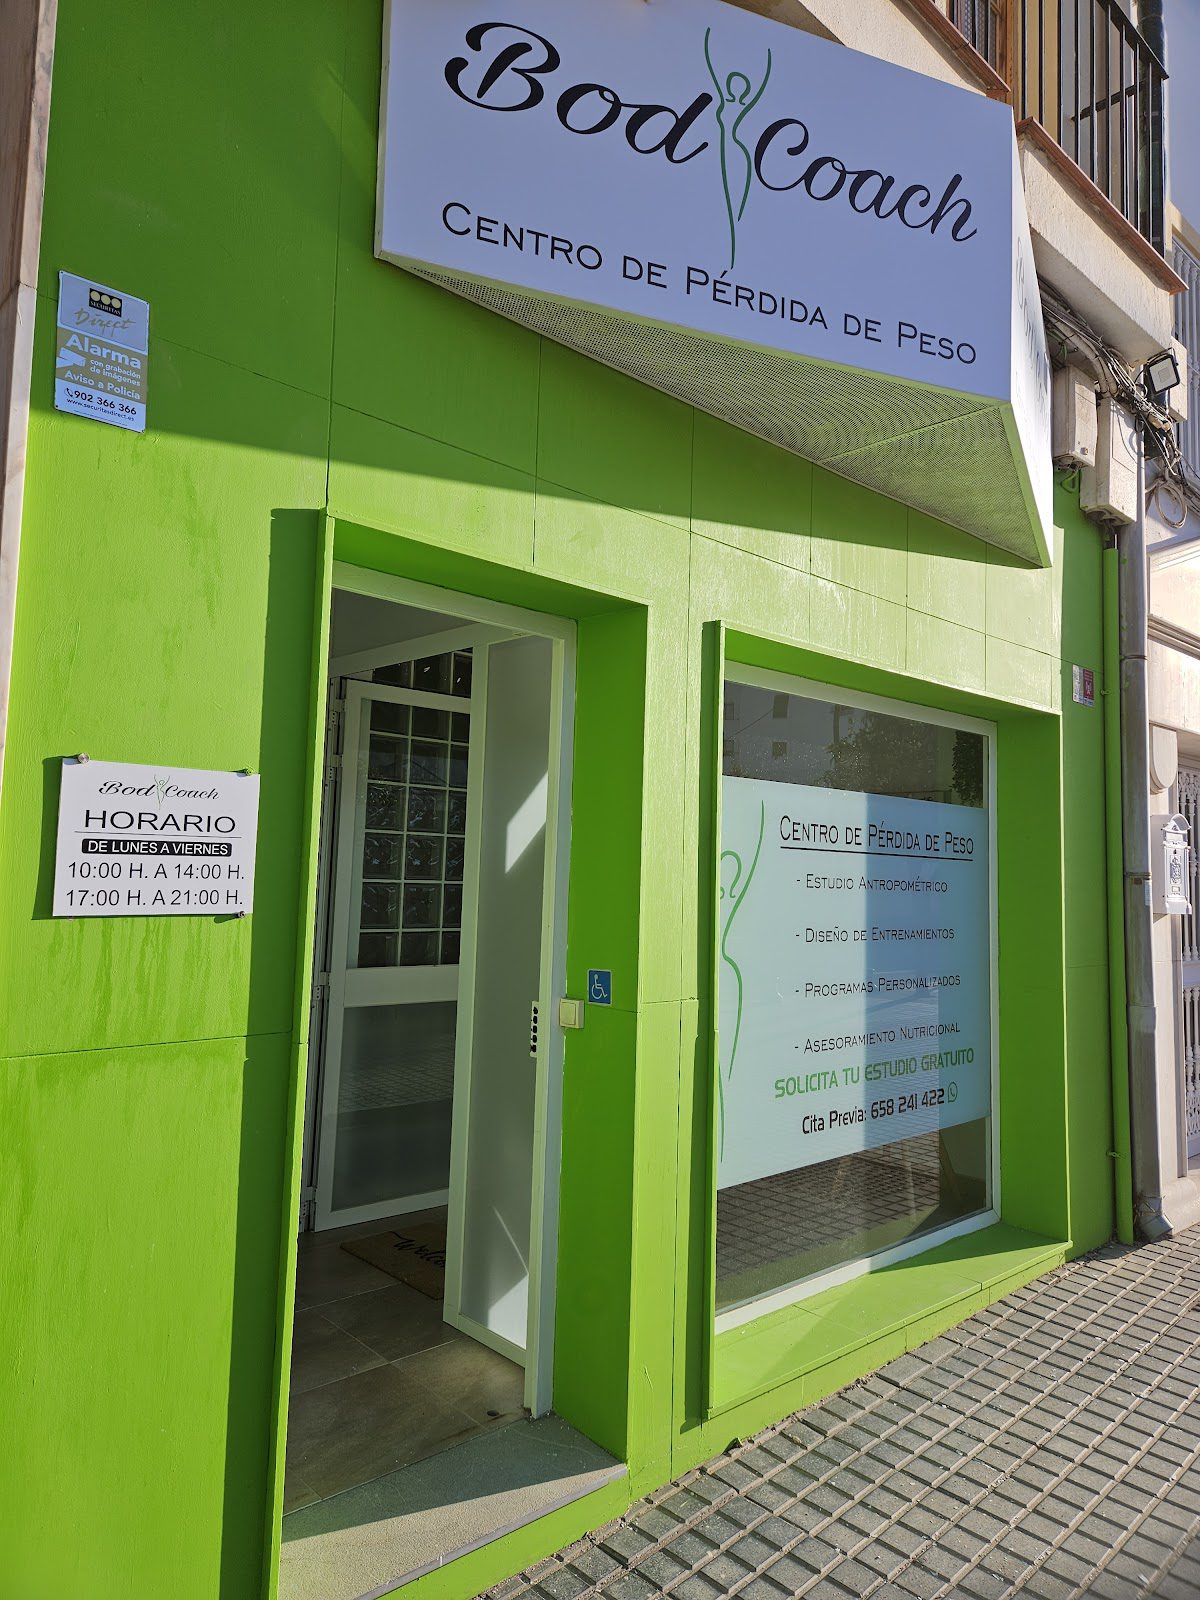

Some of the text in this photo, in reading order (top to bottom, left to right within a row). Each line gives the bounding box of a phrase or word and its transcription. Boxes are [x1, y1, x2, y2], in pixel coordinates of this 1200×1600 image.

[753, 118, 977, 242] Coach
[442, 202, 977, 365] CENTRO DE PÉRDIDA DE PESO
[66, 334, 142, 370] Alarma
[64, 370, 95, 386] Aviso
[98, 381, 104, 389] a
[90, 359, 141, 380] con grabación
[90, 366, 141, 387] de imágenes
[74, 390, 137, 415] 902 366 366
[165, 785, 220, 800] Coach
[84, 809, 236, 834] HORARIO
[779, 815, 974, 855] CENTRO DE PÉRDIDA DE PESO
[88, 840, 229, 856] DE LUNES A VIERNES
[68, 861, 245, 880] 10:00 H. A 14:00 H.
[806, 874, 854, 890] ESTUDIO
[858, 875, 948, 893] ANTROPOMÉTRICO
[66, 889, 243, 906] 17:00 H. A 21:00 H.
[805, 926, 849, 943] DISEÑO
[853, 930, 868, 942] DE
[872, 927, 955, 941] ENTRENAMIENTOS
[805, 981, 874, 998] PROGRAMAS
[878, 975, 961, 992] PERSONALIZADOS
[803, 1030, 896, 1054] ASESORAMIENTO
[900, 1022, 961, 1040] NUTRICIONAL
[774, 1048, 975, 1099] SOLICITA TU ESTUDIO GRATUITO
[802, 1088, 945, 1135] Cita Previa: 658 241 422
